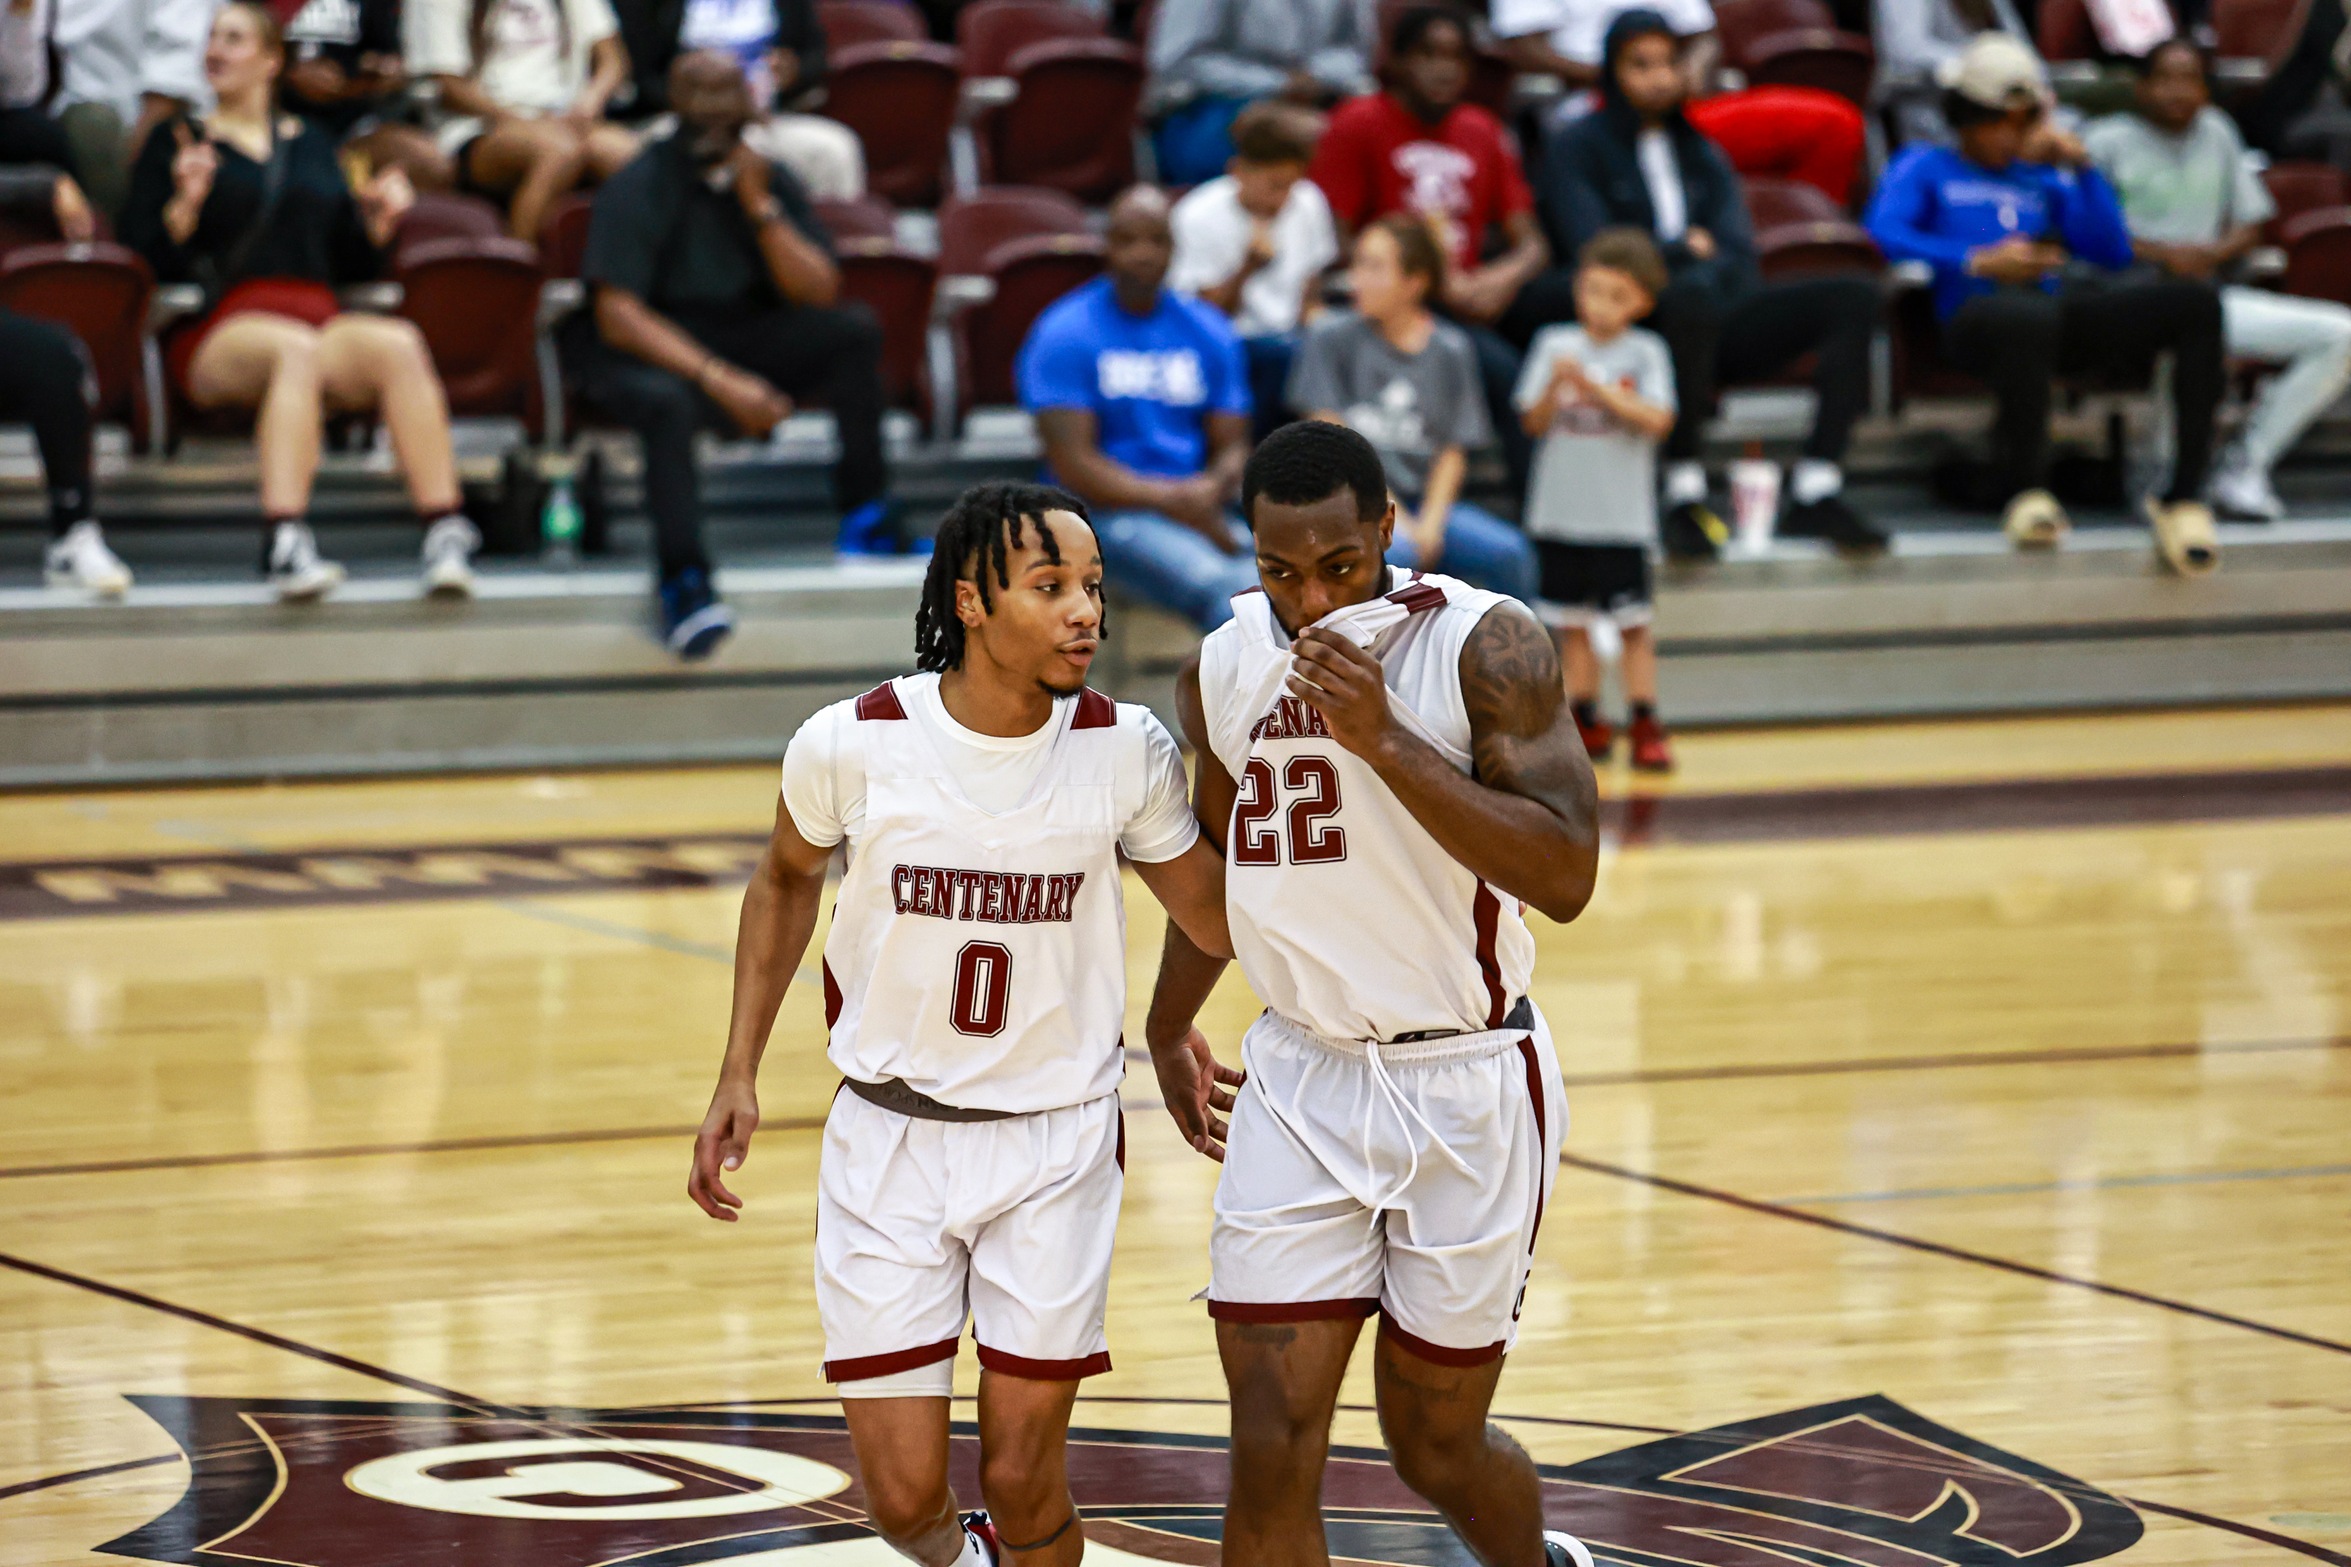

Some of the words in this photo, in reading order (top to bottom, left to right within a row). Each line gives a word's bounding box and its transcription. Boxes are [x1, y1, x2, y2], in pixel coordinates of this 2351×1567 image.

[1234, 755, 1347, 866] 22
[891, 863, 1085, 924] CENTENARY
[949, 939, 1013, 1038] 0
